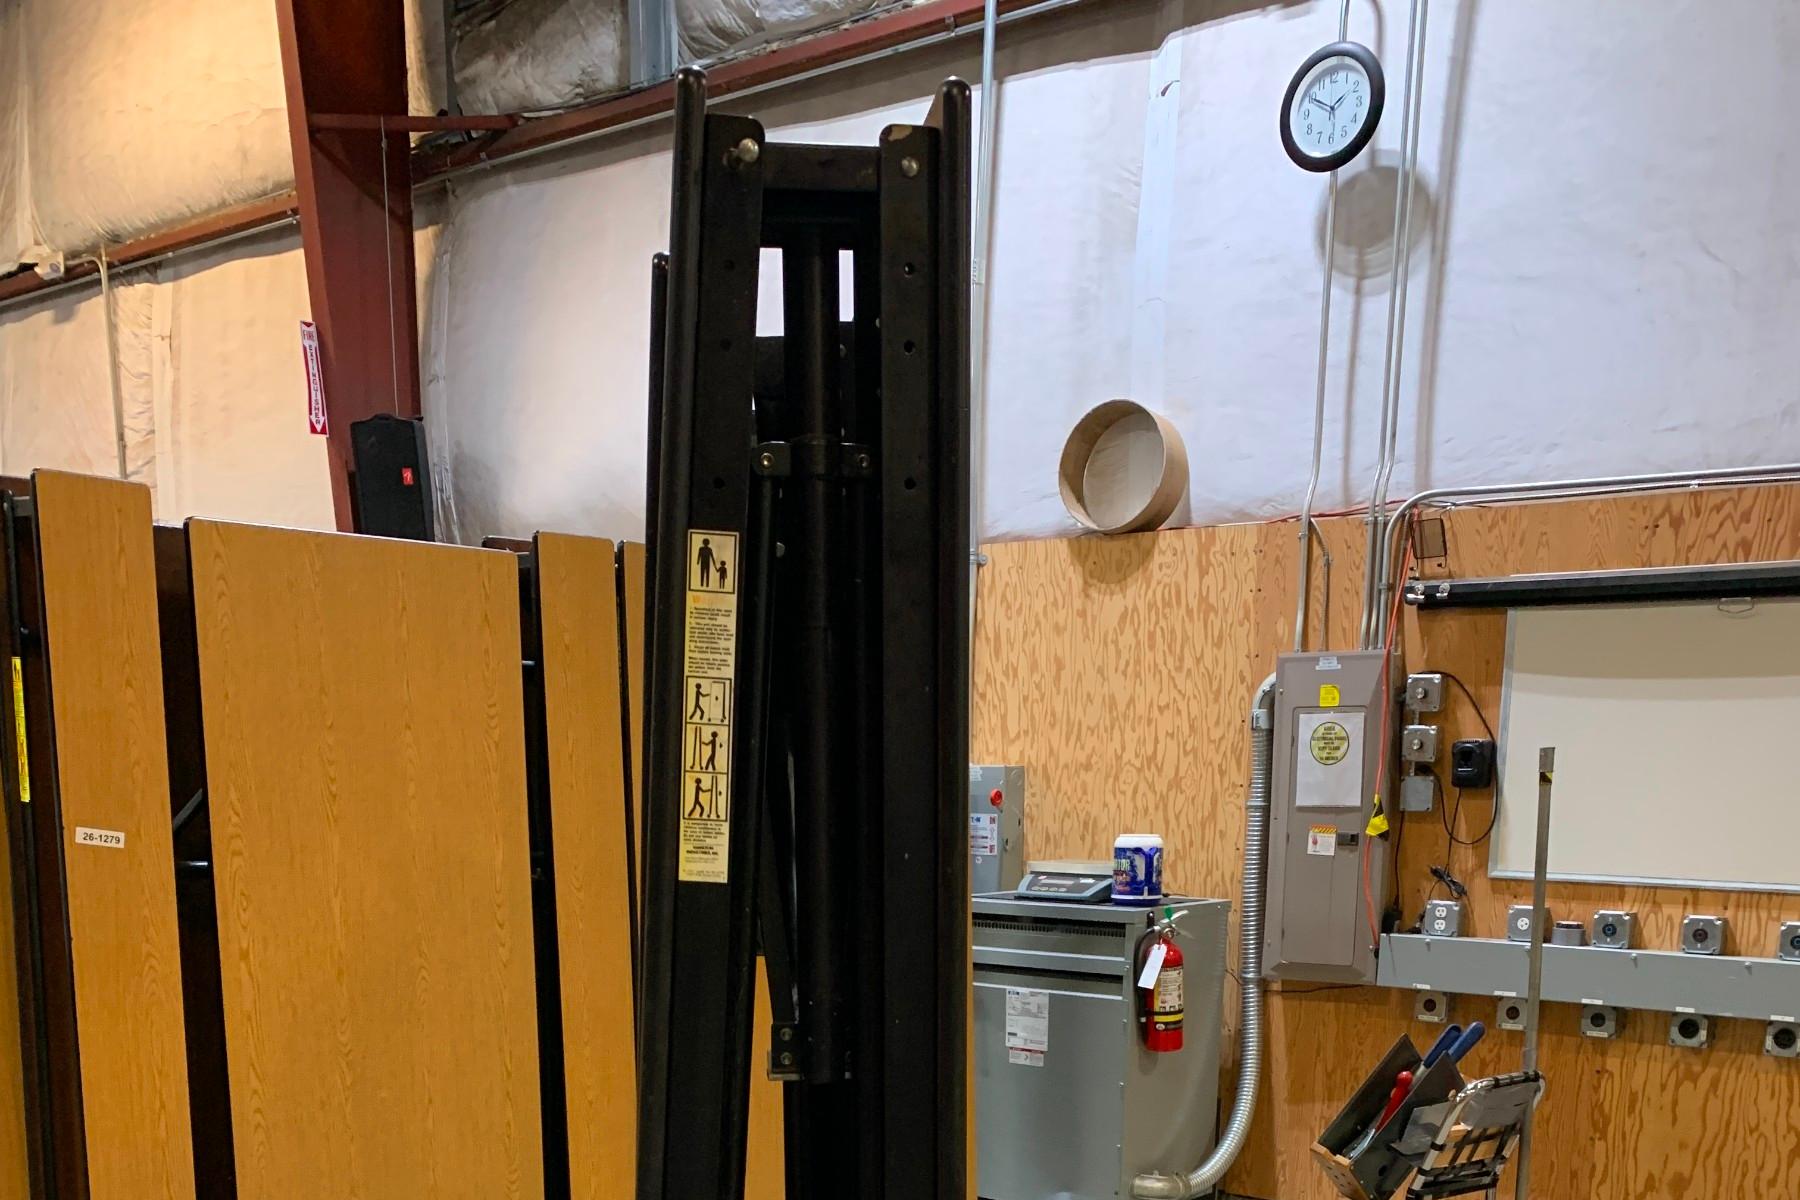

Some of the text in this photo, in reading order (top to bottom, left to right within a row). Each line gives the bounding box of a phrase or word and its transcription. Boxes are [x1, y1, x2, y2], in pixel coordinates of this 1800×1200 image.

[1330, 71, 1339, 84] 12
[1318, 79, 1326, 91] 11
[1352, 80, 1360, 93] 2
[1356, 95, 1363, 108] 3
[1303, 108, 1310, 120] 9
[1350, 113, 1357, 124] 4
[1306, 123, 1313, 136] 8
[1340, 125, 1348, 137] 5
[1316, 131, 1323, 144] 7
[1328, 131, 1335, 144] 6
[303, 330, 315, 341] FIRE
[308, 344, 321, 425] EXTINGUISHER
[82, 832, 121, 845] 26-1279
